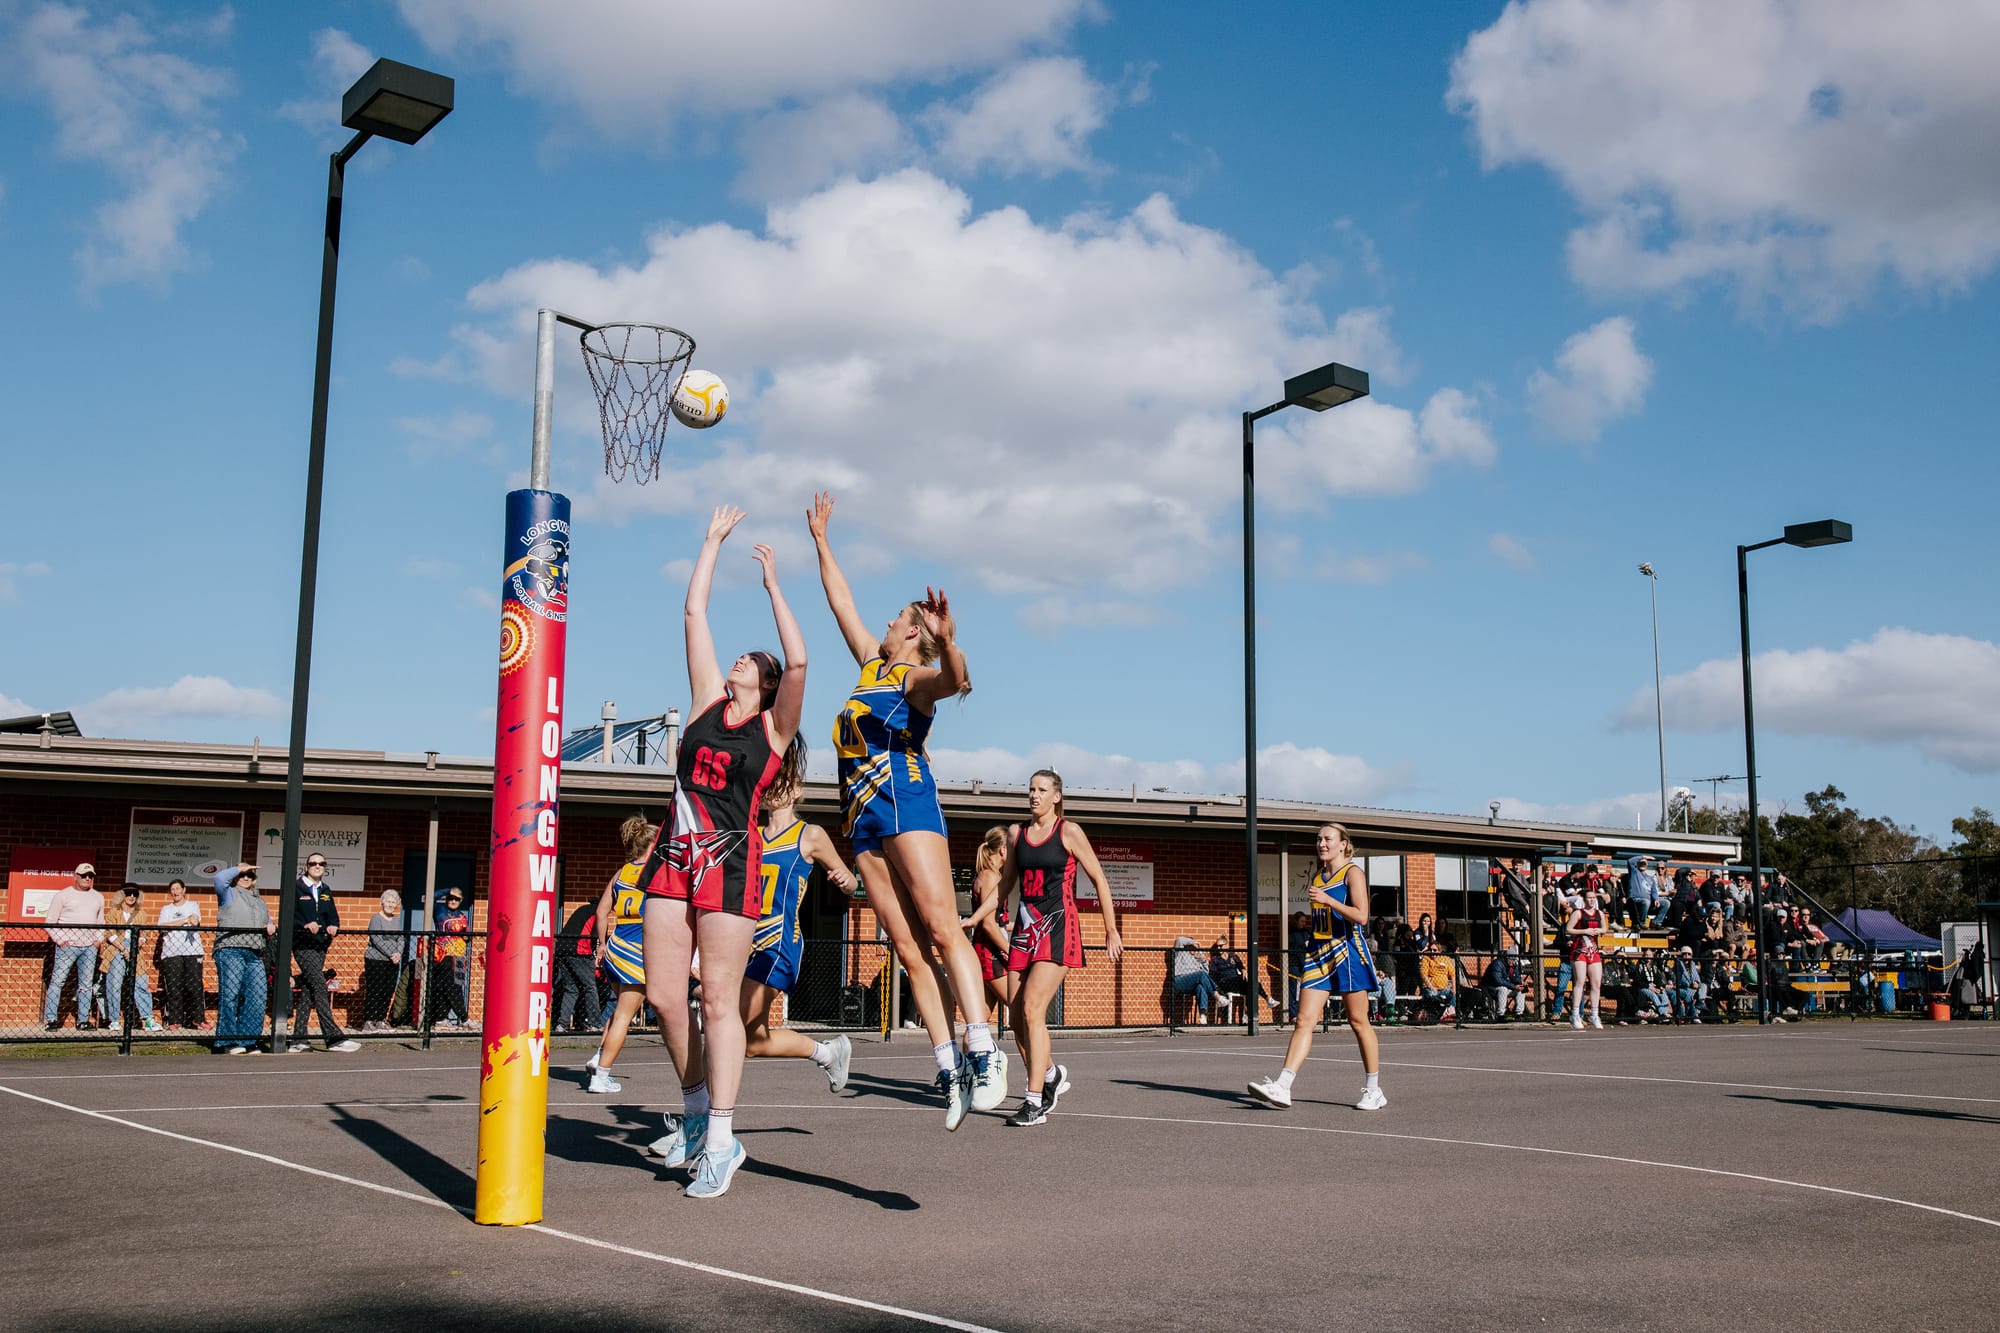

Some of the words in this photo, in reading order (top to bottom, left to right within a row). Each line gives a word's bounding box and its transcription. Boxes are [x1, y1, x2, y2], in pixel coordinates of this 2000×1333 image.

[512, 575, 545, 615] FOOTBALL
[546, 609, 553, 619] &
[691, 745, 732, 791] GS
[172, 815, 215, 825] gourmet
[527, 676, 560, 1077] LONGWARRY
[1023, 868, 1045, 897] GA
[623, 896, 634, 917] C
